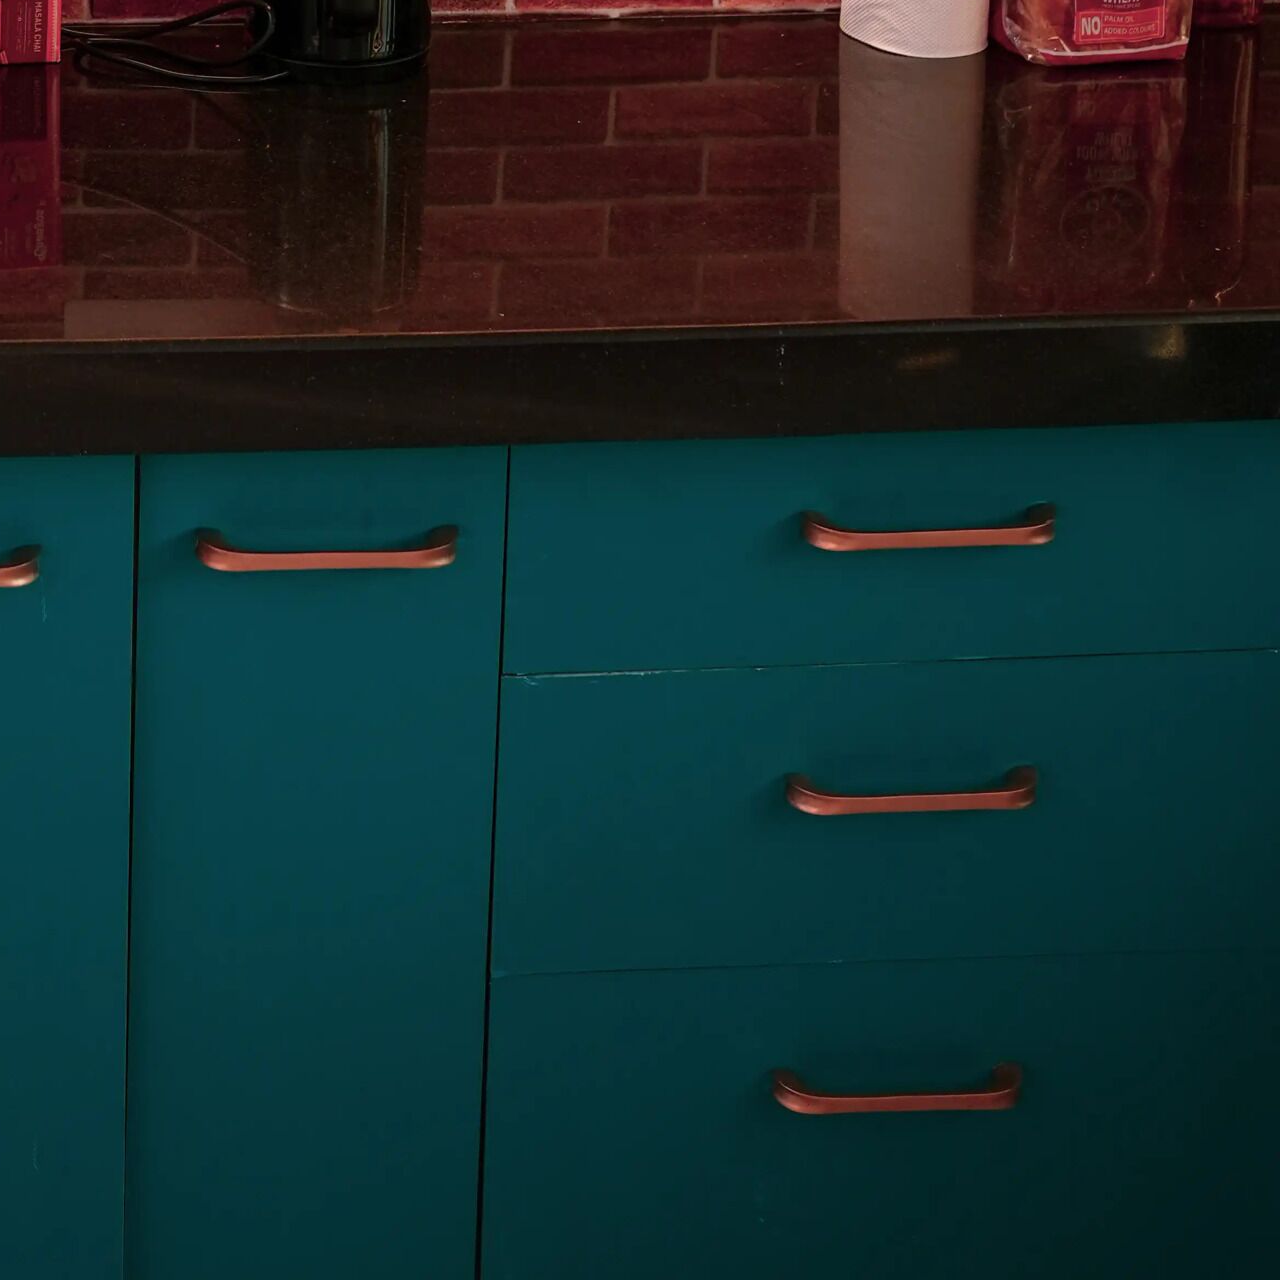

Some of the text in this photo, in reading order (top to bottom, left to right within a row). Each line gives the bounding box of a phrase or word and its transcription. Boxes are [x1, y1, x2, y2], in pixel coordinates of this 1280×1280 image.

[33, 1, 43, 53] MASALA CHAI
[1081, 15, 1101, 36] NO
[1104, 15, 1124, 23] PALM
